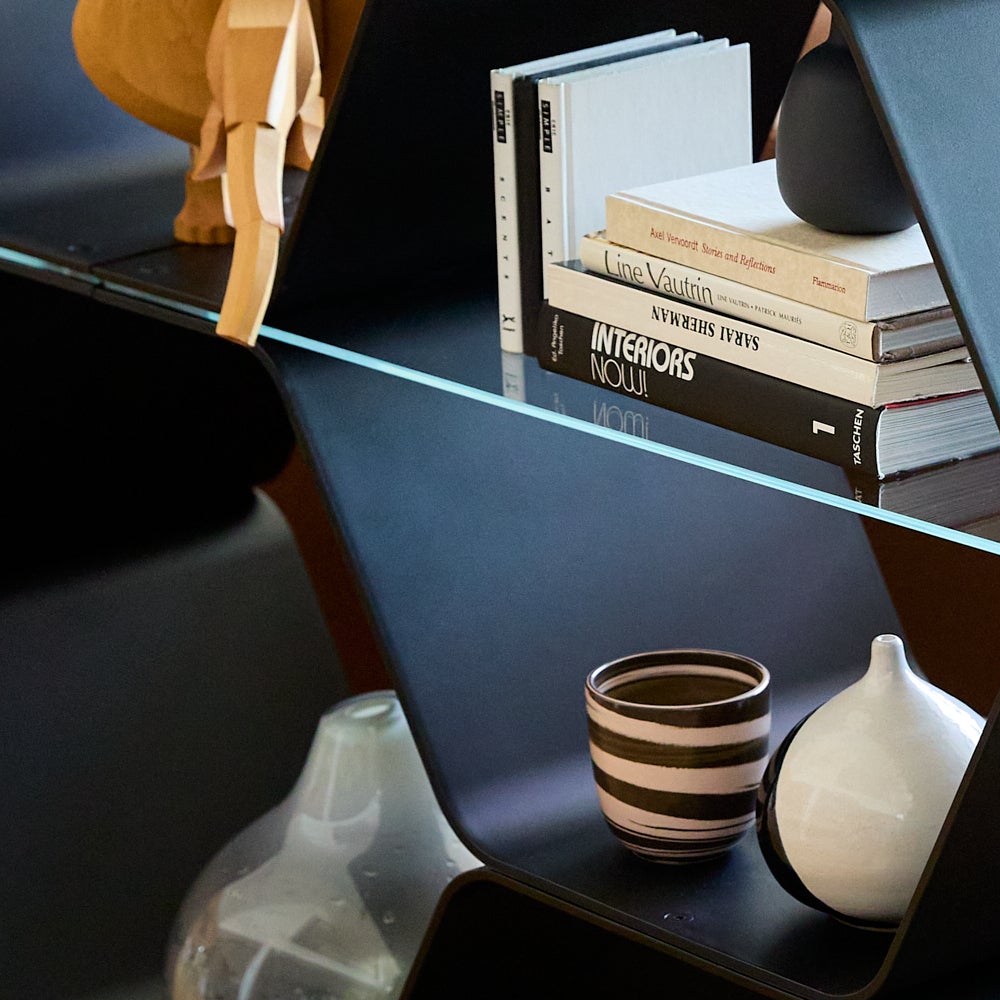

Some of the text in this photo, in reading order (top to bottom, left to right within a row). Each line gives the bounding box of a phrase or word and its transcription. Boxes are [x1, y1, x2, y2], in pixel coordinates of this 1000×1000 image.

[541, 102, 553, 151] SIMPLE
[650, 227, 776, 275] Axel Vervoordt Stories and Reflections
[604, 250, 714, 305] Line Vautrin
[812, 276, 846, 294] Flammarion
[651, 305, 760, 351] SARAI SHERMAN
[717, 294, 727, 302] LINE
[728, 296, 750, 309] VAUTRIN
[754, 304, 776, 317] PATRICK
[590, 353, 649, 398] NOW!
[591, 322, 697, 382] INTERIORS
[813, 420, 836, 435] 1
[853, 409, 865, 465] TASCHEN
